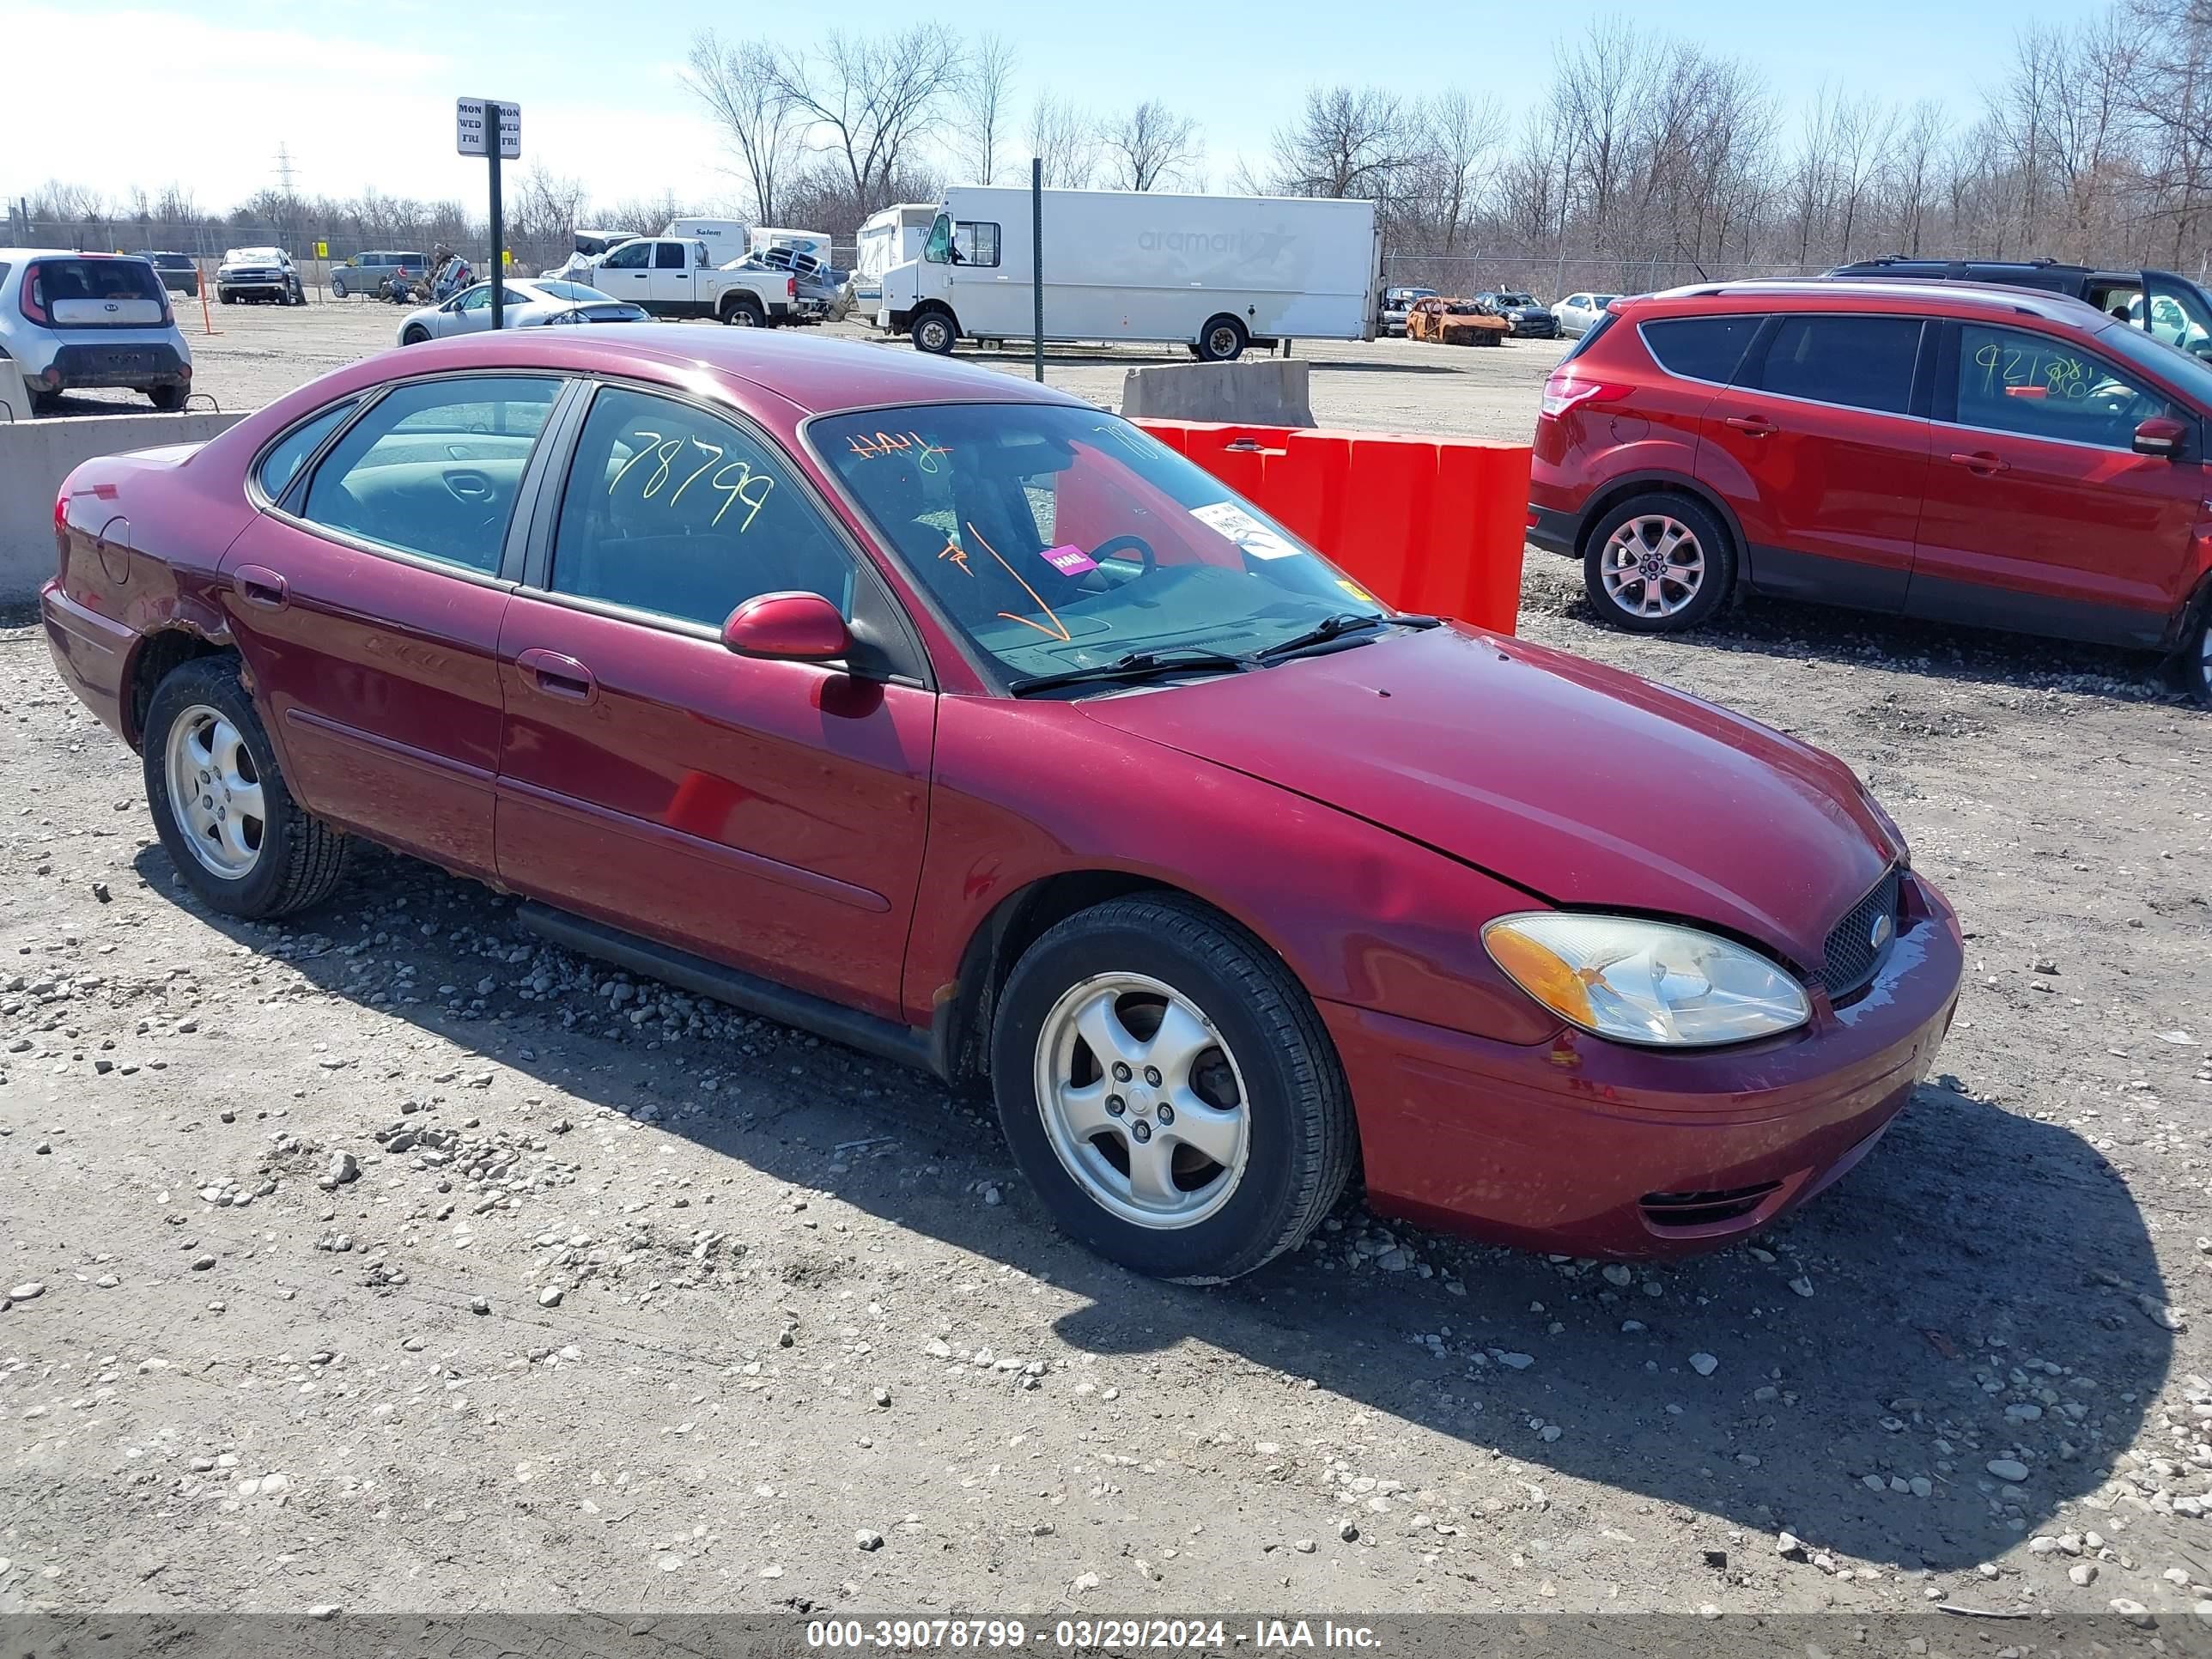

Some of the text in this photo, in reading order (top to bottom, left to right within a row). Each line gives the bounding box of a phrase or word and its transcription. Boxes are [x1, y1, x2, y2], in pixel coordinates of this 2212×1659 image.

[459, 104, 482, 114] MON
[459, 119, 482, 129] WED
[462, 134, 479, 143] FRI
[608, 431, 775, 534] 78799
[1052, 552, 1087, 568] HAIL
